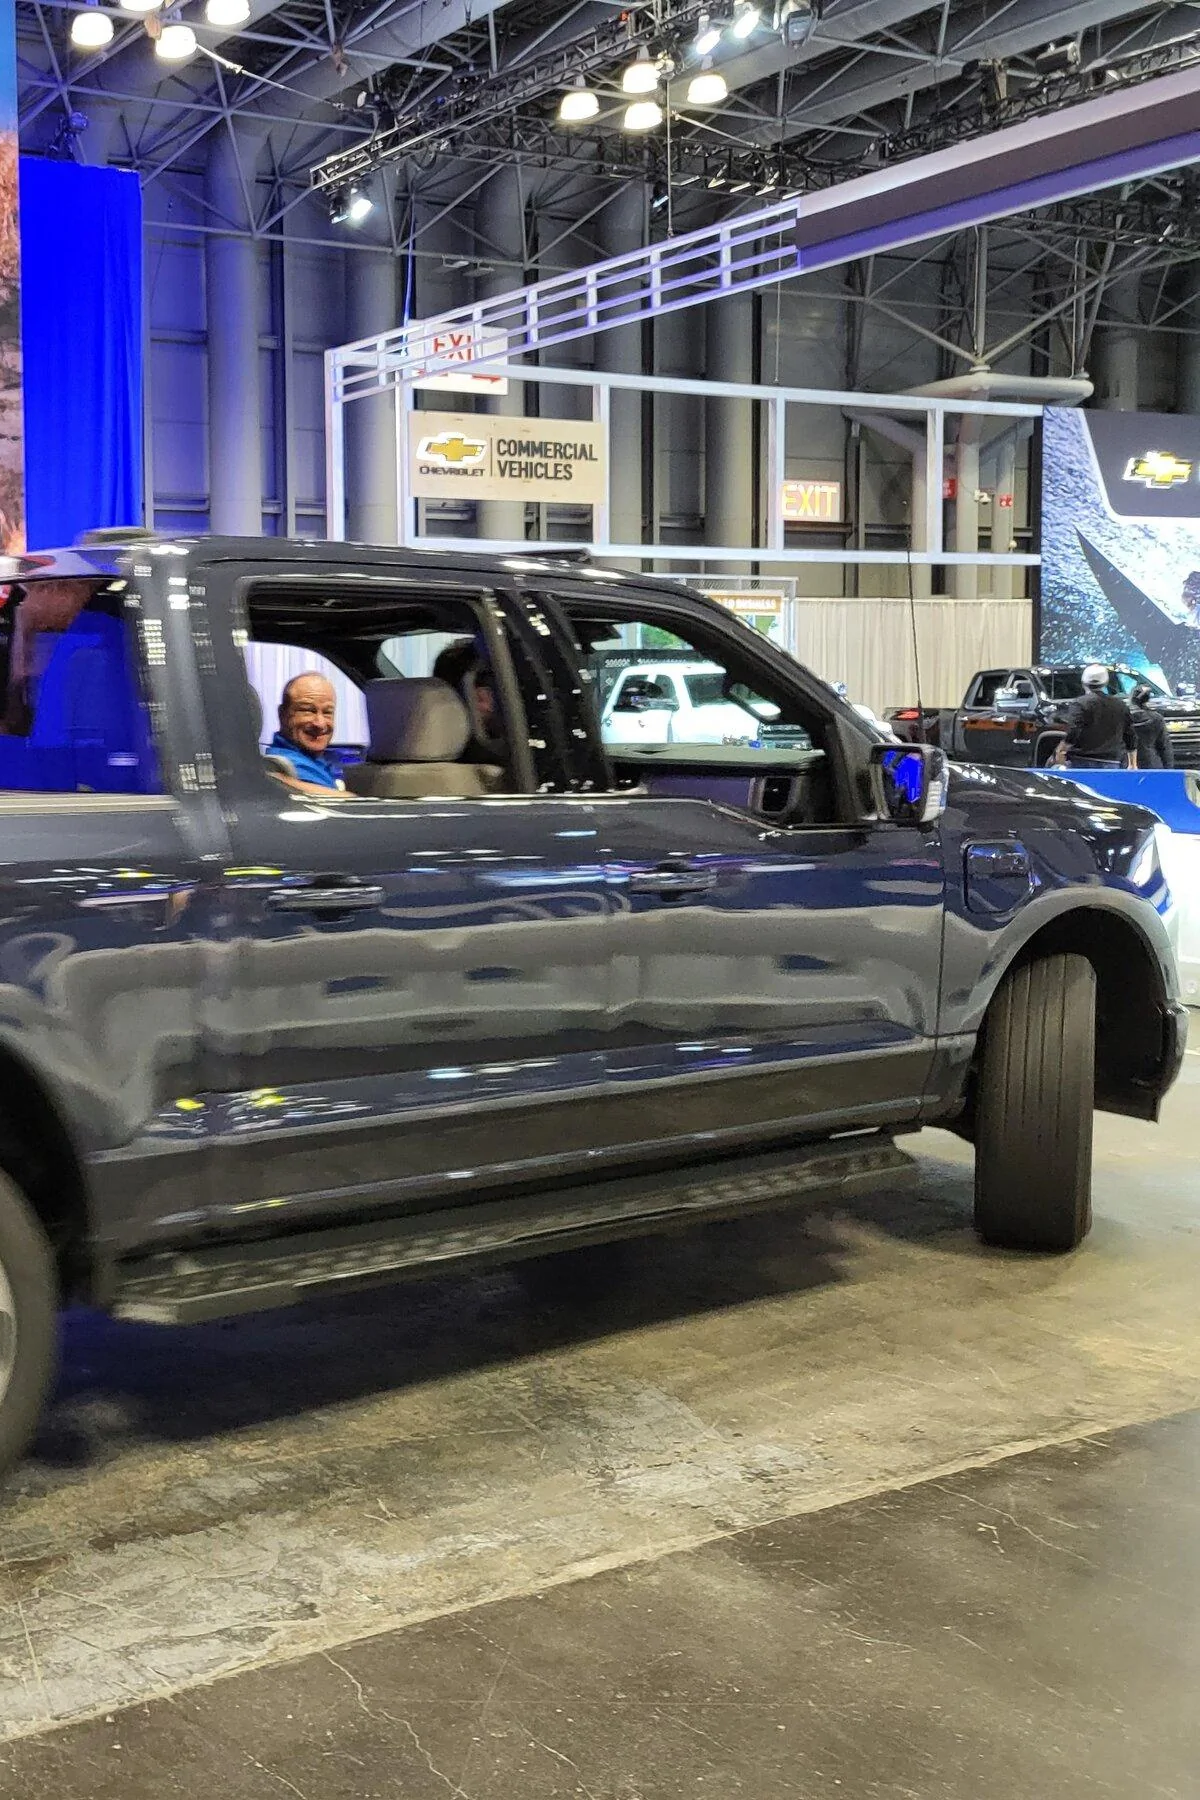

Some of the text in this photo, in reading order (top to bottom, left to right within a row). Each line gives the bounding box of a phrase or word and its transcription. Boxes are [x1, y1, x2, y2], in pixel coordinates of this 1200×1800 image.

[433, 333, 484, 361] EXI
[496, 438, 598, 462] COMMERCIAL
[419, 465, 486, 477] CHEVROLET
[497, 460, 573, 481] VEHICLES
[781, 484, 838, 517] EXIT
